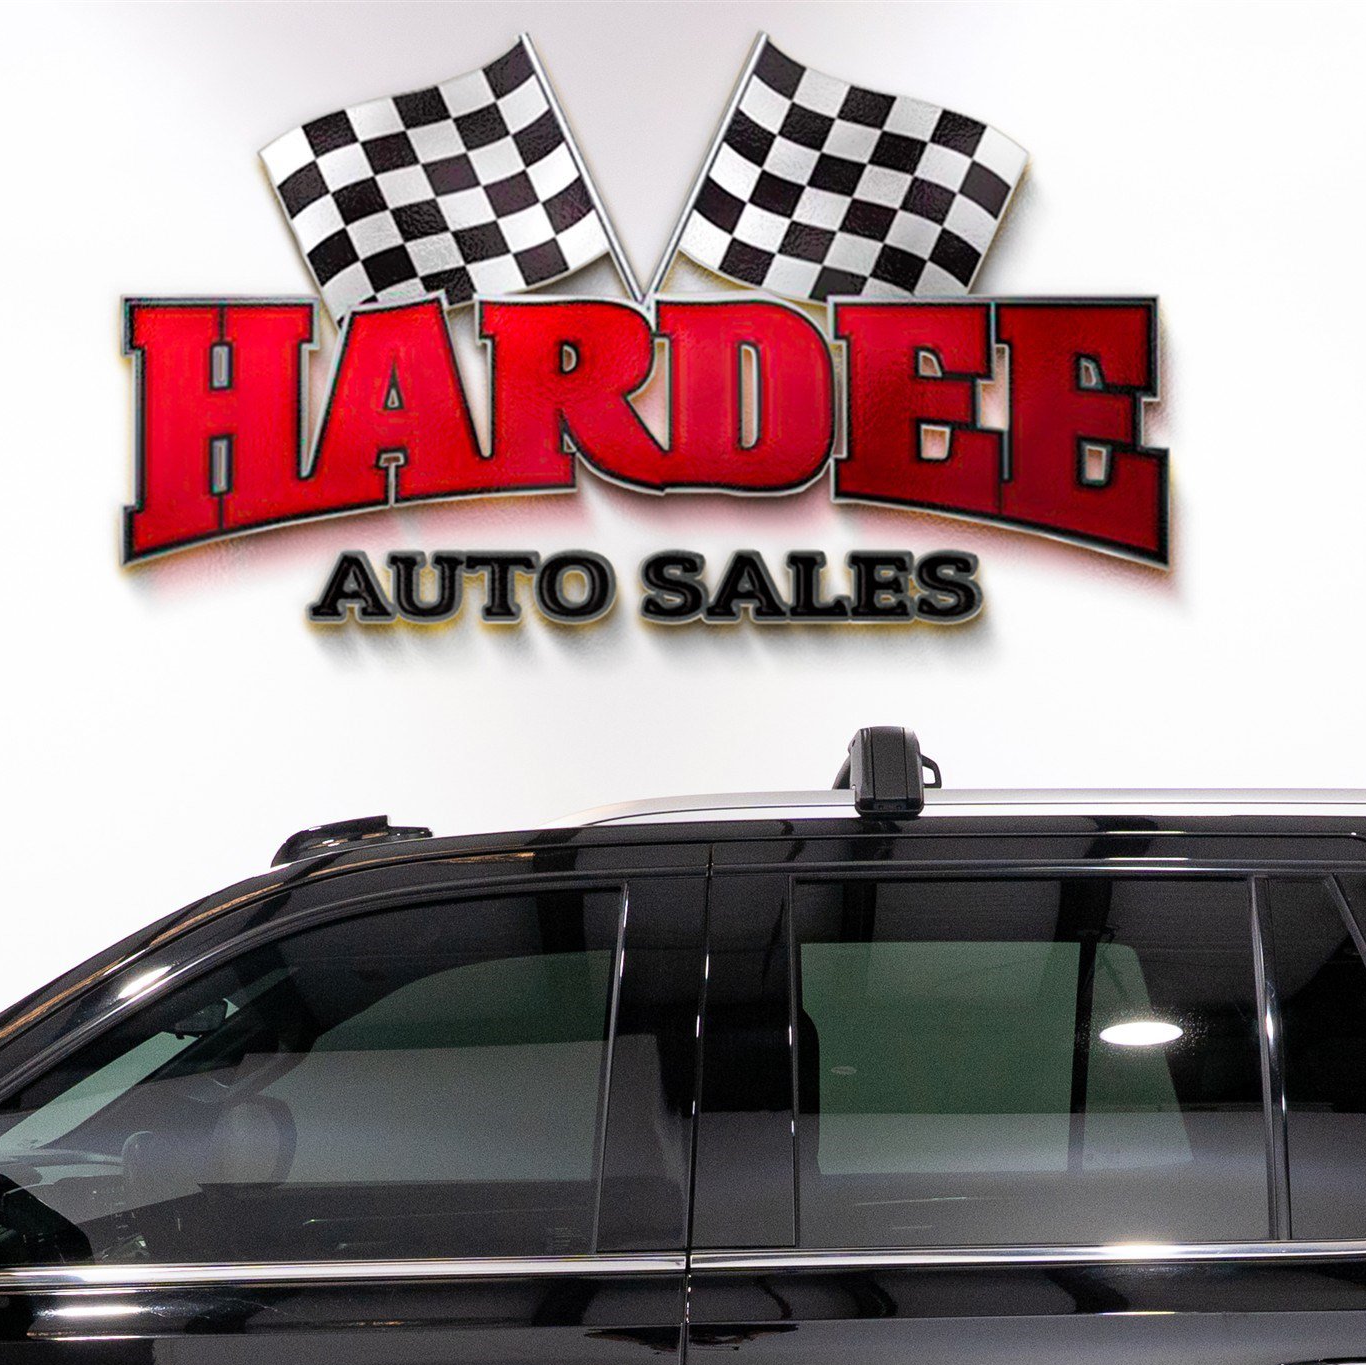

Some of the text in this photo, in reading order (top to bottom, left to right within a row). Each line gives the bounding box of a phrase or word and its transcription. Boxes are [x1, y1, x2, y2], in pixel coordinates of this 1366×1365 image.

[121, 296, 1172, 565] HARDEE
[307, 549, 985, 624] AUTO SALES
